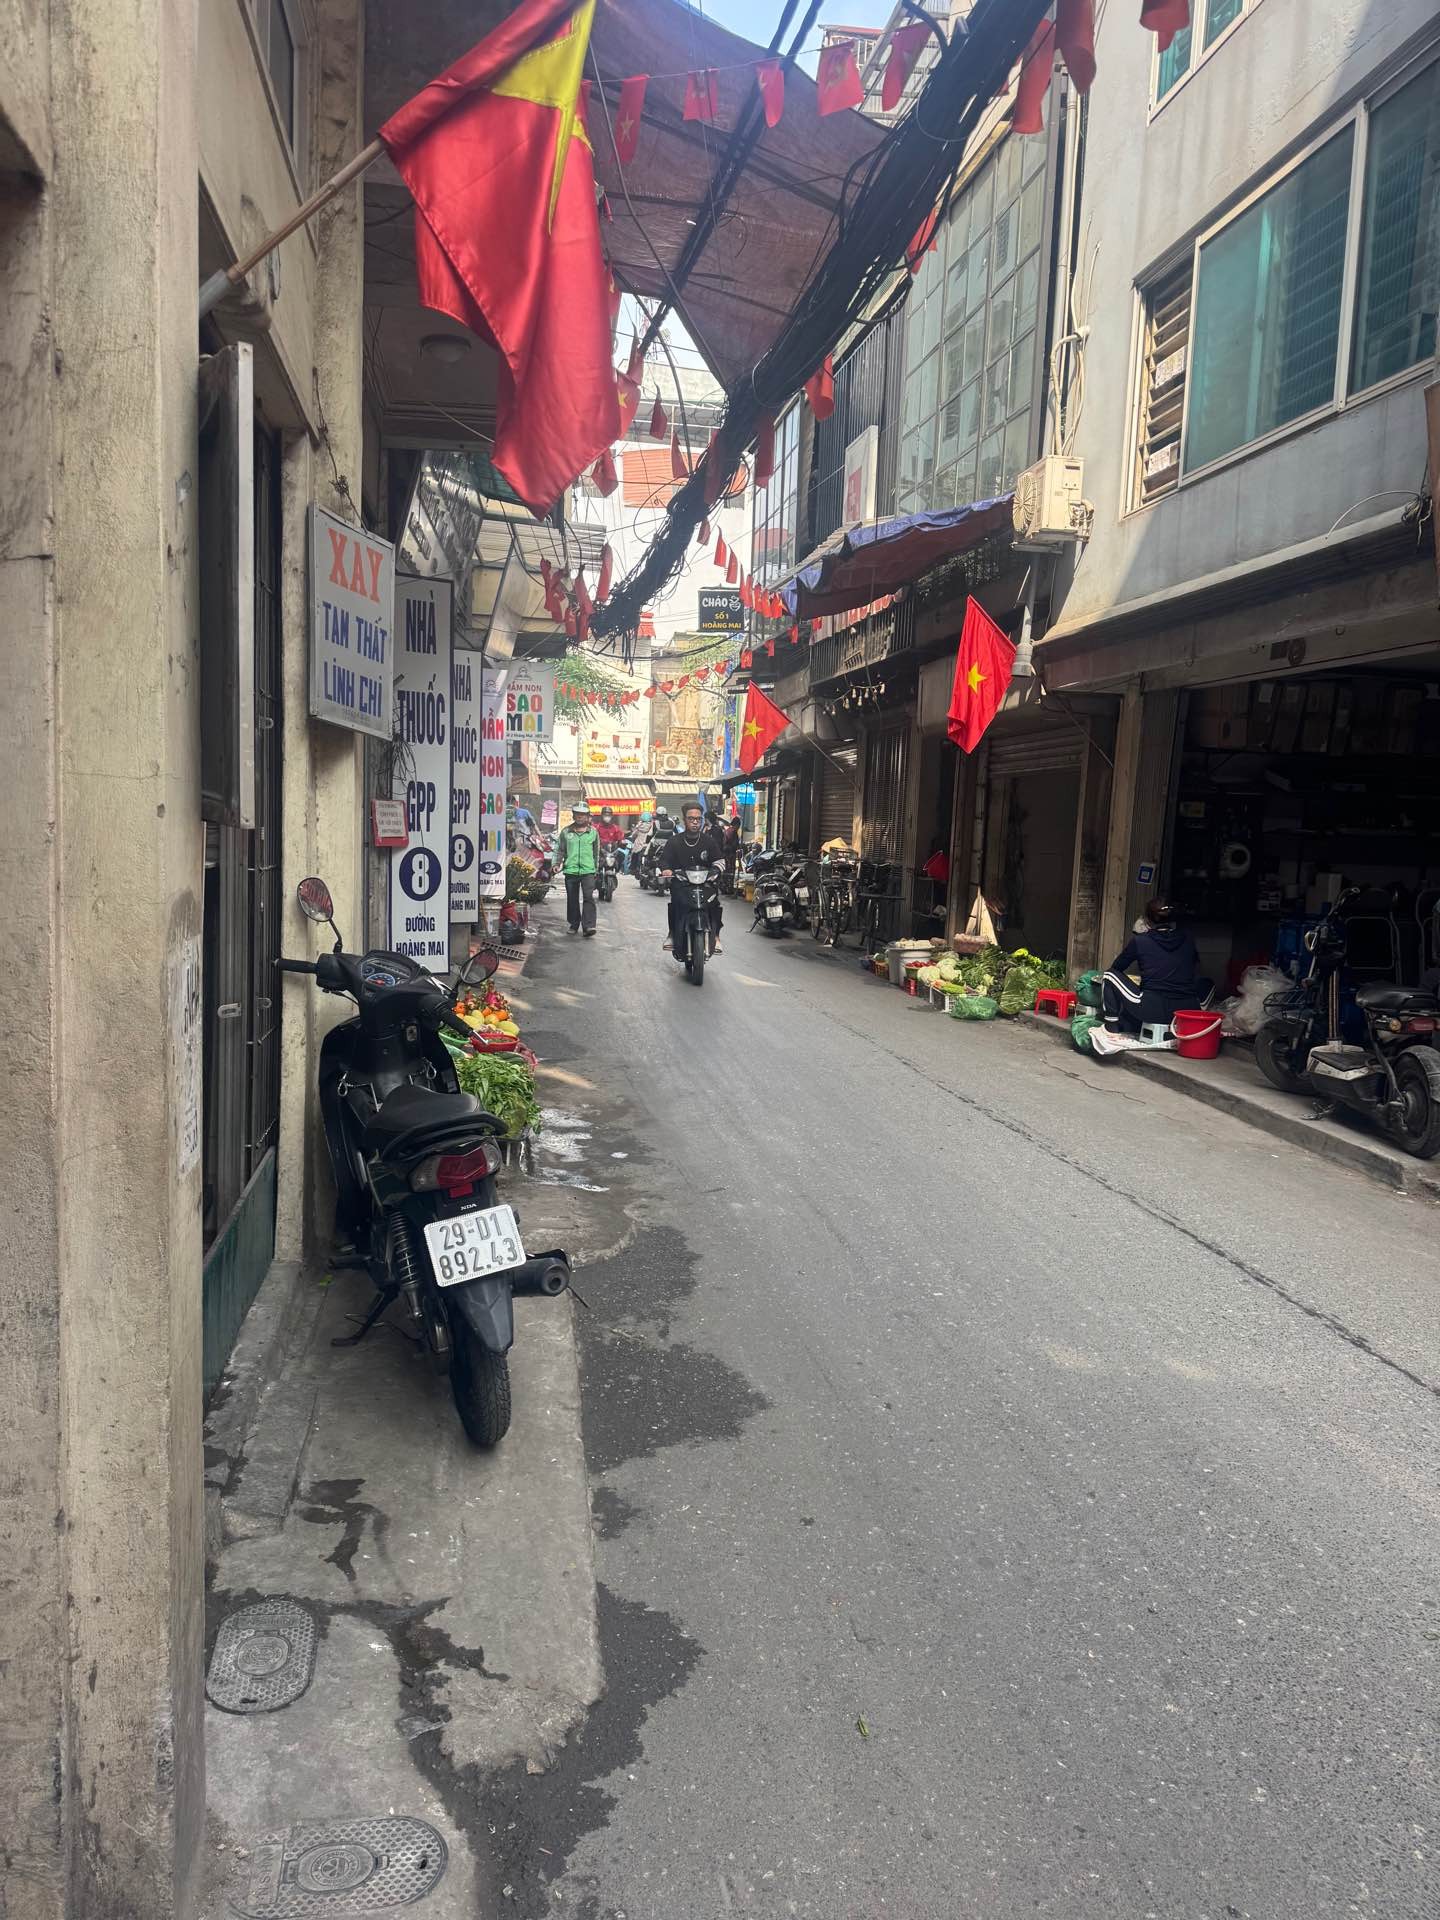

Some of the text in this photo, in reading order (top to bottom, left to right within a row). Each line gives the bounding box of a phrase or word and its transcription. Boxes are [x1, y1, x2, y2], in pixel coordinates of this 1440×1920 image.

[327, 527, 385, 605] XAY
[322, 600, 388, 665] TAM THẤT
[405, 589, 437, 655] NHÀ
[506, 693, 543, 713] SAO
[525, 684, 542, 692] NON
[397, 673, 446, 746] THUỐC
[506, 713, 543, 732] MAI
[406, 780, 436, 833] GPP
[451, 788, 471, 825] GPP
[480, 792, 504, 815] SAO
[453, 838, 467, 868] 8
[480, 830, 502, 851] MAI
[411, 853, 430, 896] 8
[464, 899, 476, 911] MAI
[405, 912, 436, 933] ĐƯỜNG
[396, 939, 445, 957] HOÀNG MAI
[440, 1212, 502, 1251] 29-D1
[439, 1238, 518, 1280] 892.43
